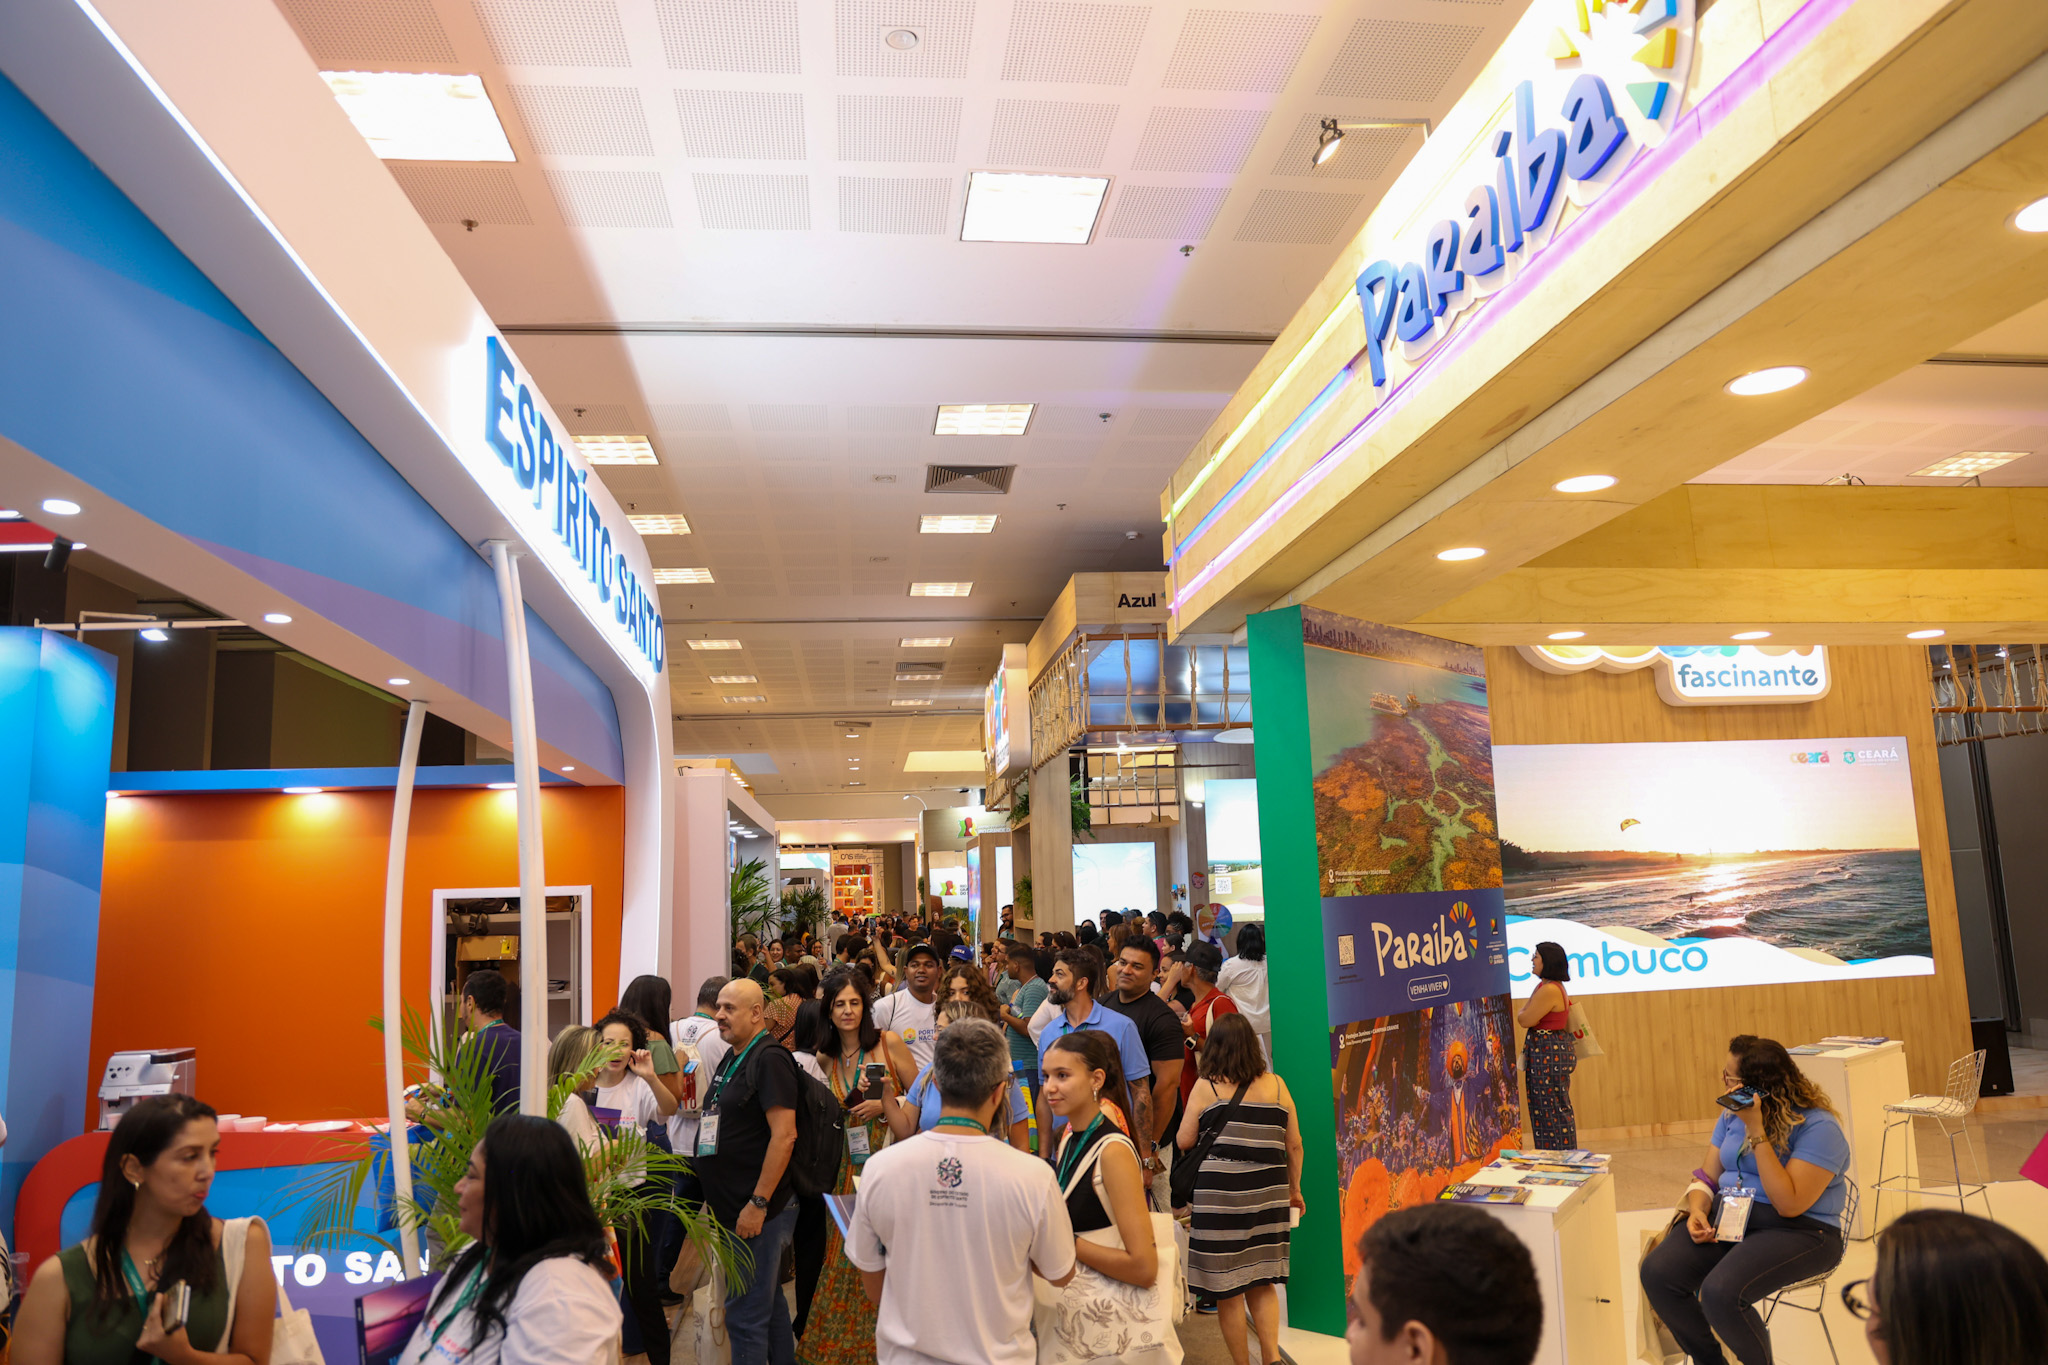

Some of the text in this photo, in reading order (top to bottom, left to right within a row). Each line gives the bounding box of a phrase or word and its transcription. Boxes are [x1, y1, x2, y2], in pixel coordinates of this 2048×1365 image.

[1117, 593, 1156, 608] Azul
[615, 554, 664, 673] SANTO
[1678, 664, 1818, 688] fascinante
[1858, 747, 1898, 759] CEARÁ
[1508, 941, 1708, 981] Cmbuco
[1410, 984, 1428, 995] VENHA
